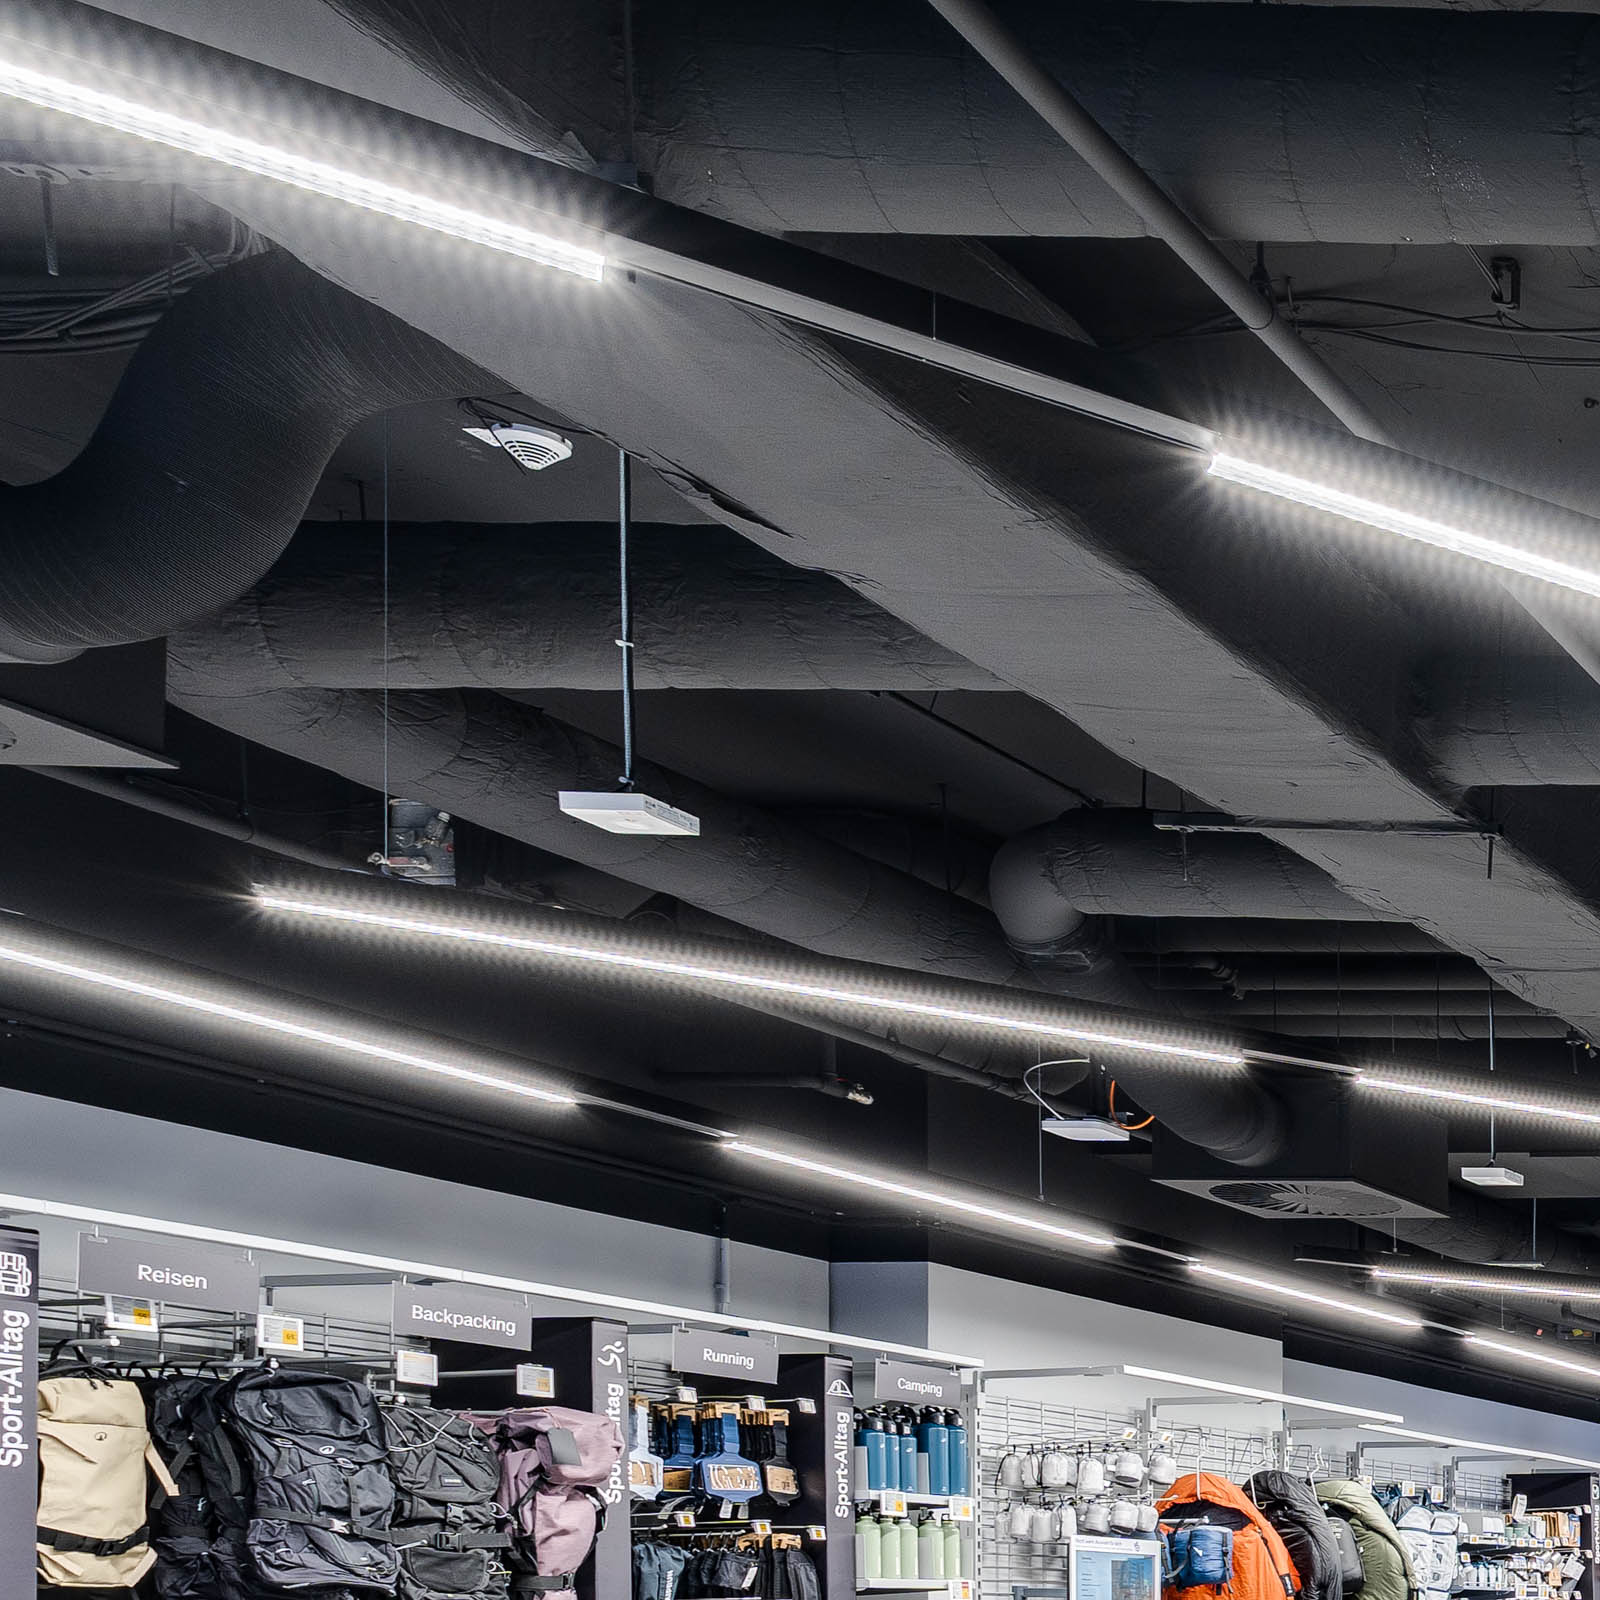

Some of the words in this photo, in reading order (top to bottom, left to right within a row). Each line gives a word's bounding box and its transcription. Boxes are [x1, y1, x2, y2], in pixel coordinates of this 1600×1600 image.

[137, 1264, 208, 1290] Reisen
[411, 1304, 516, 1337] Backpacking
[703, 1348, 754, 1370] Running
[896, 1377, 943, 1398] Camping
[833, 1410, 850, 1519] Sport-Alltag
